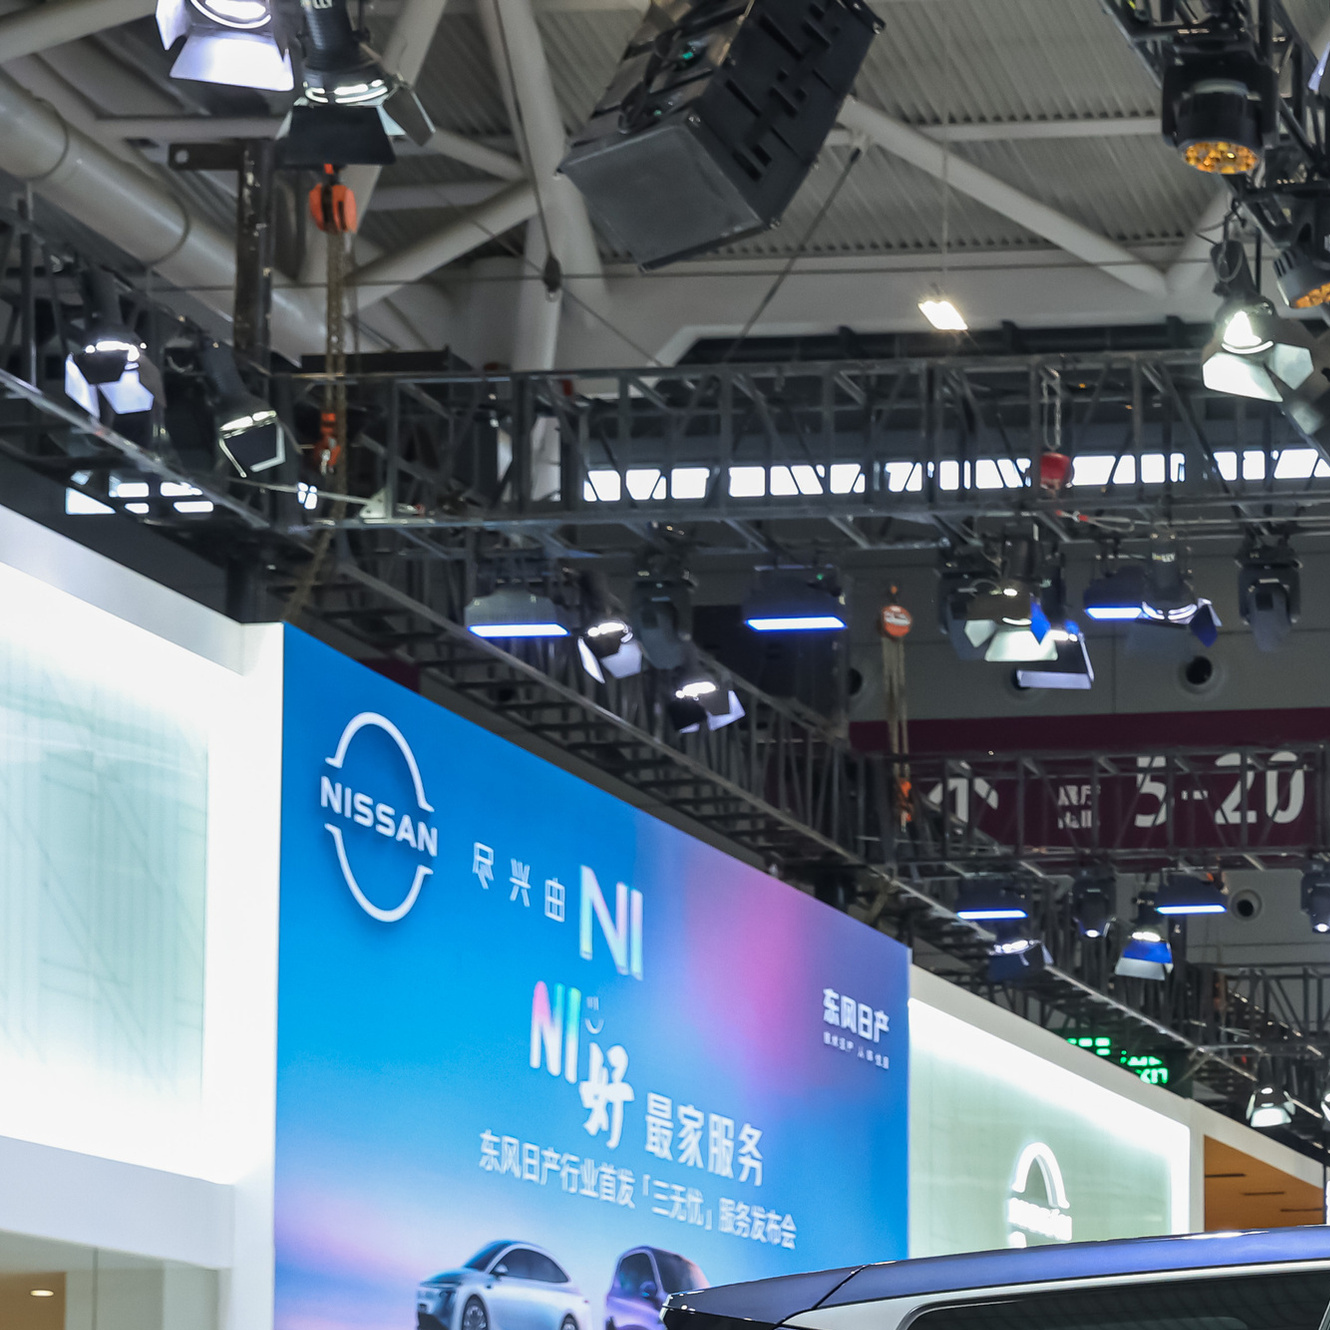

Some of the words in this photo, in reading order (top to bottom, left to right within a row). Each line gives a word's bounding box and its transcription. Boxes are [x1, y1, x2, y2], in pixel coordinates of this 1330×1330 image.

[320, 775, 438, 857] NISSAN
[823, 987, 890, 1043] 东风日产
[645, 1091, 763, 1187] 最家服务
